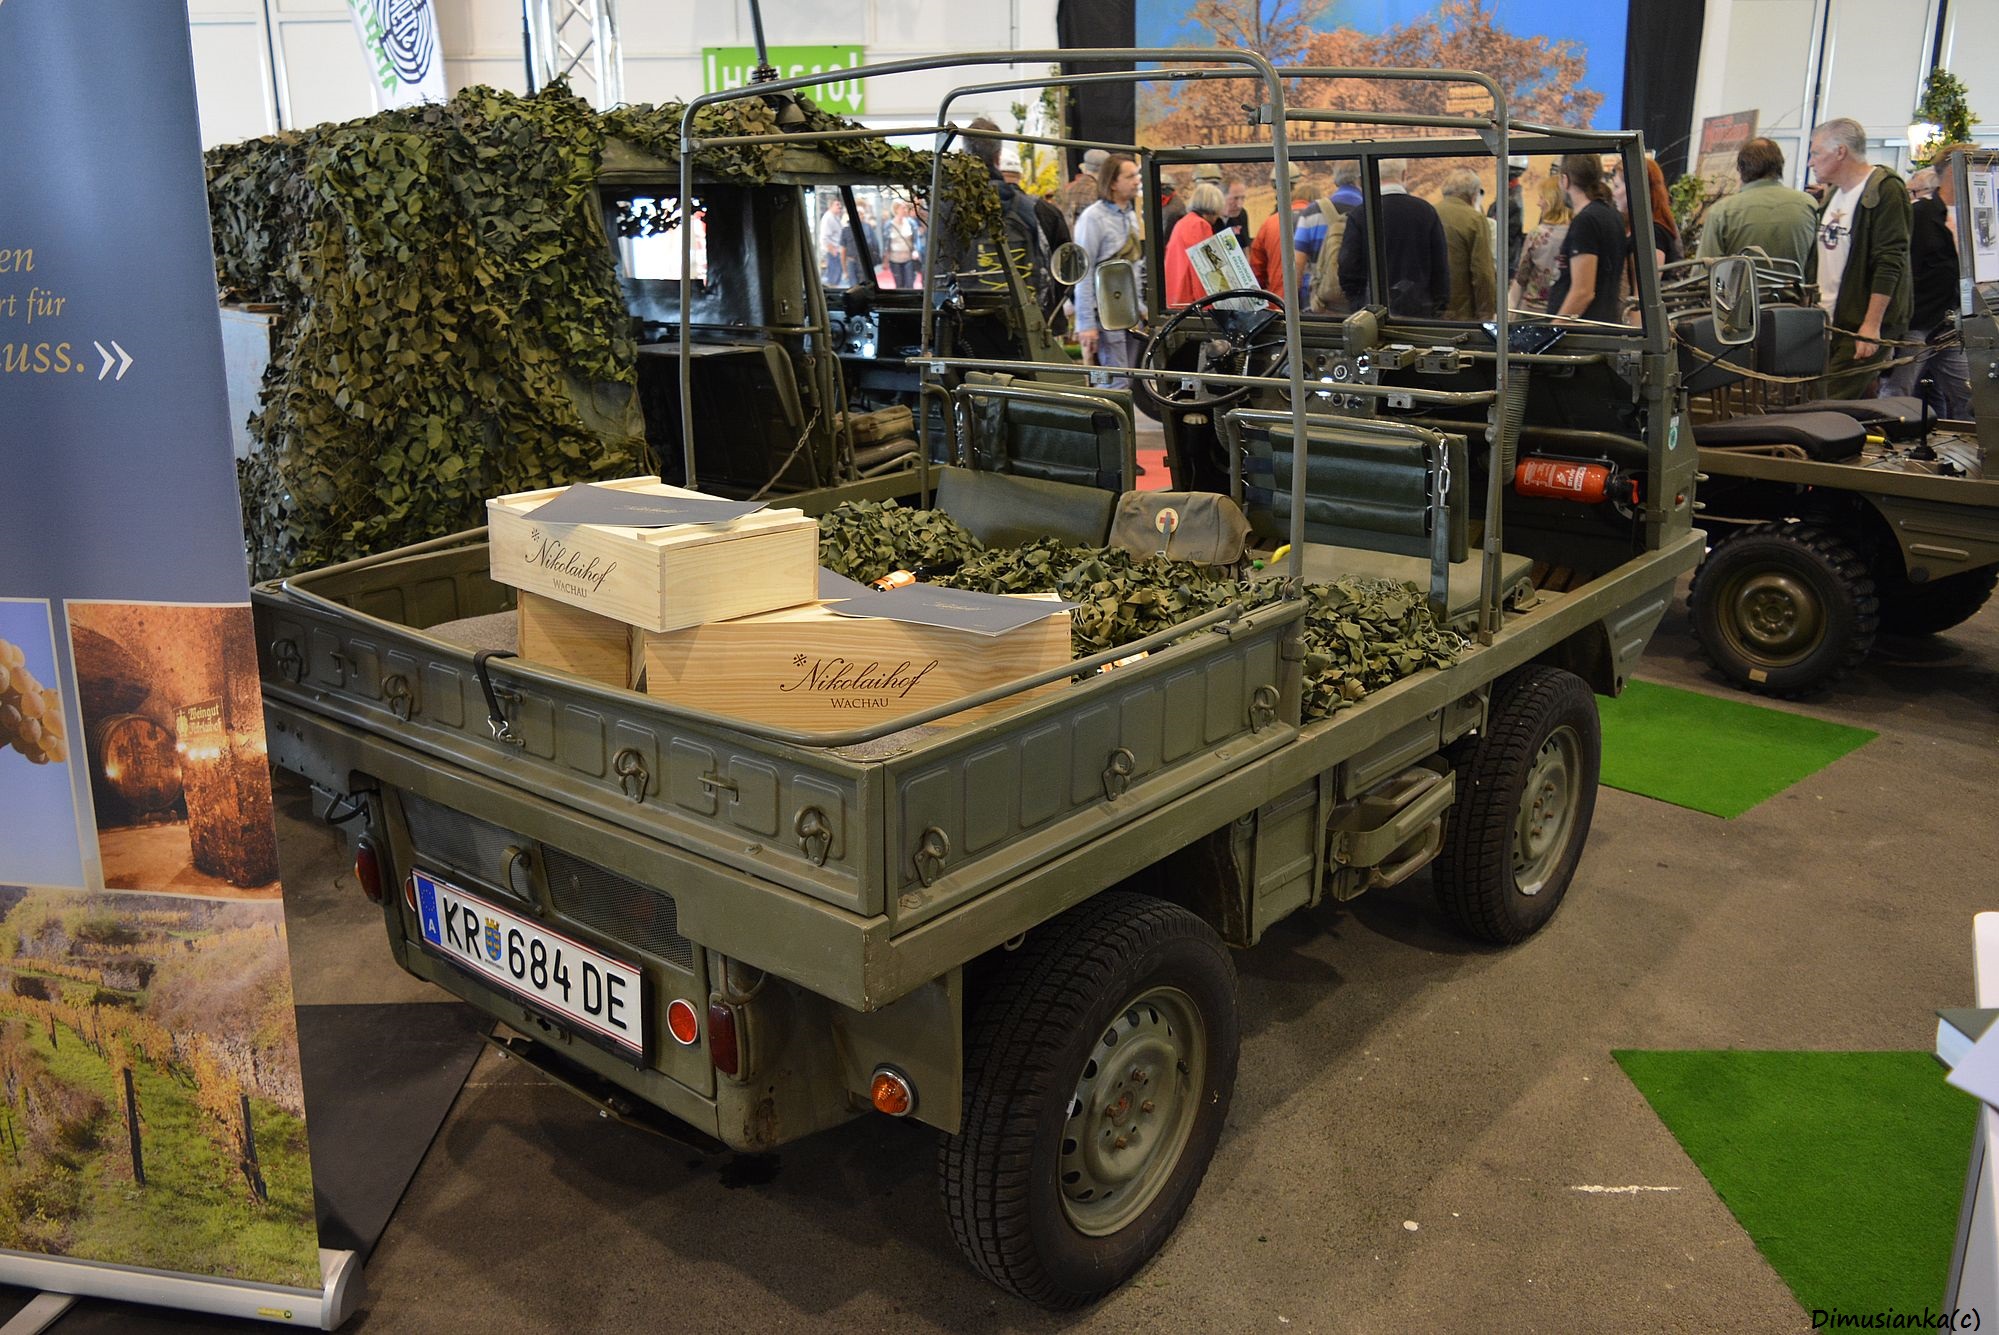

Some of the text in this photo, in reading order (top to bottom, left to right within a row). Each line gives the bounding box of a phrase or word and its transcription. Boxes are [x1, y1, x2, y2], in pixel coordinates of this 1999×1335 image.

[811, 64, 847, 102] 10
[27, 287, 66, 324] für
[524, 536, 617, 593] Nikolaihof
[552, 578, 588, 599] WACHAU
[780, 657, 939, 698] Nikolaihof
[830, 697, 889, 709] WACHAU
[428, 918, 437, 935] A
[443, 894, 628, 1031] KR 684 DE
